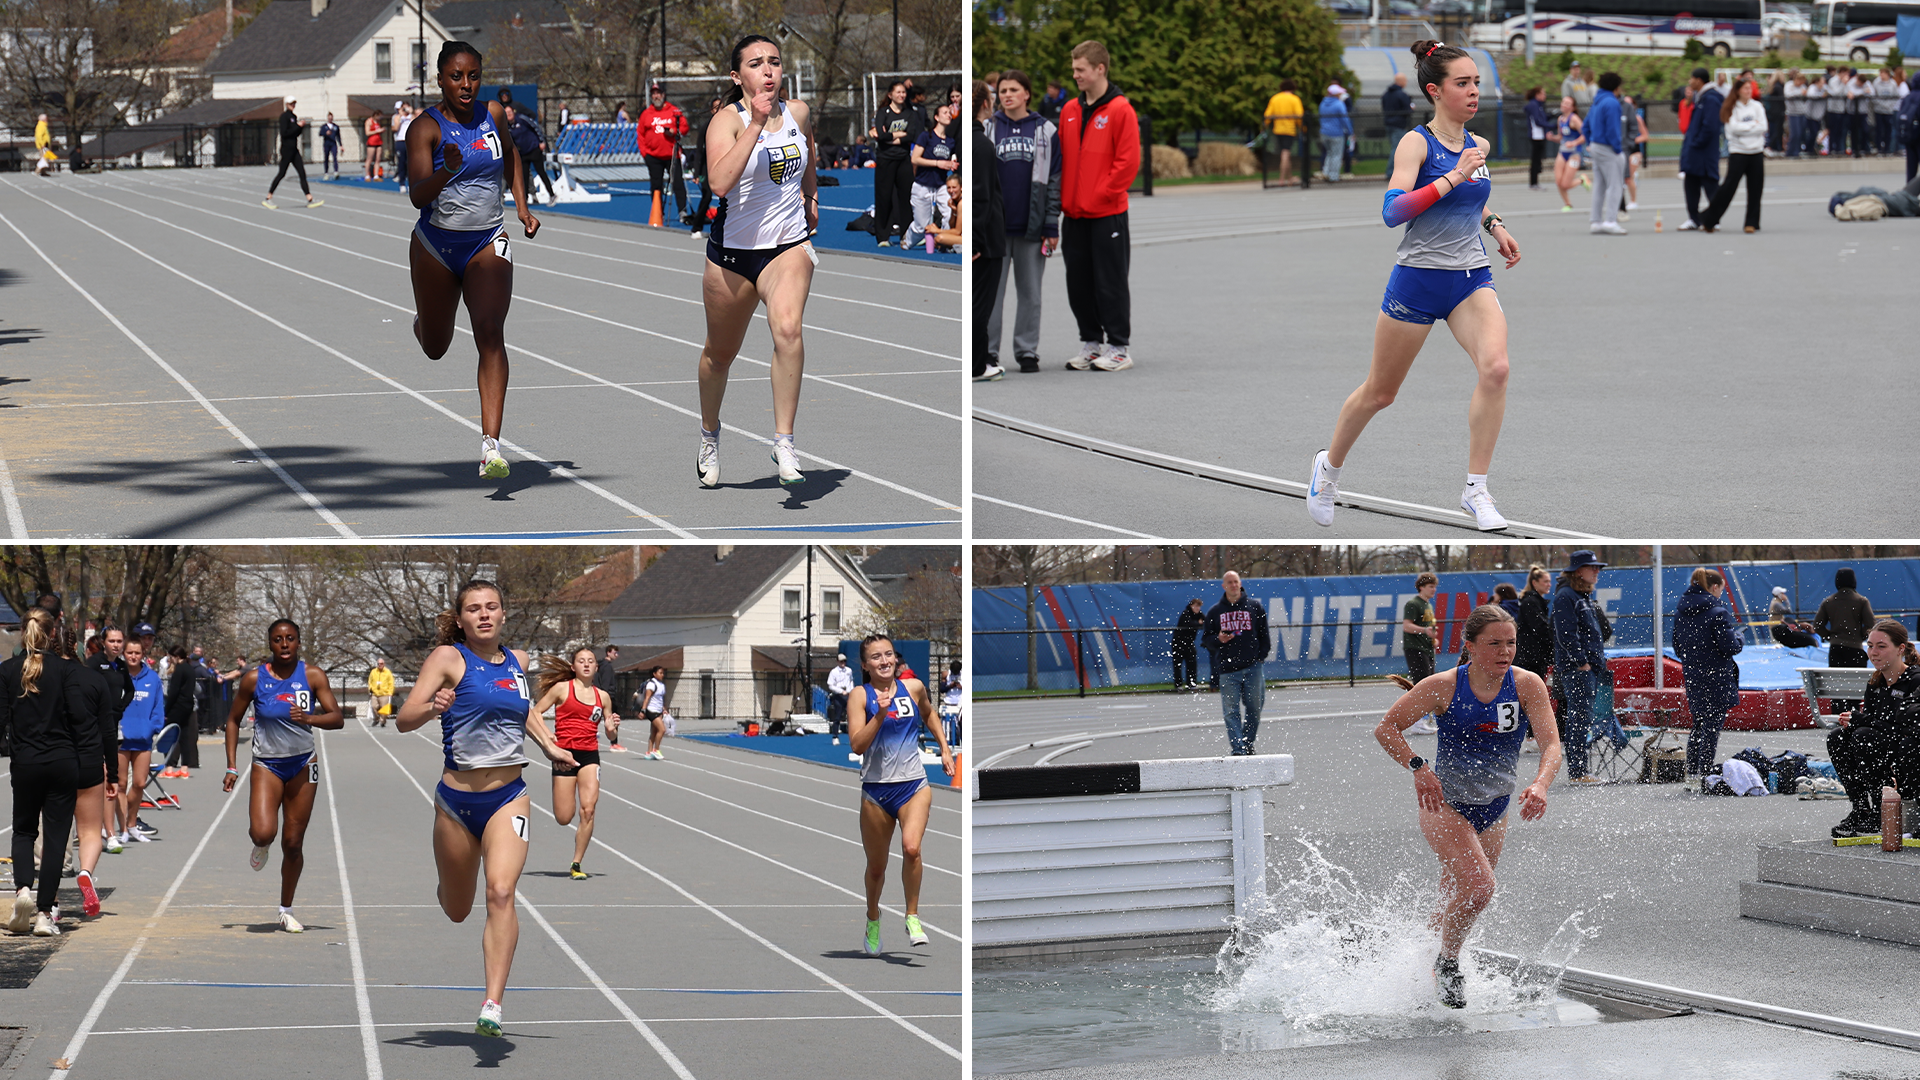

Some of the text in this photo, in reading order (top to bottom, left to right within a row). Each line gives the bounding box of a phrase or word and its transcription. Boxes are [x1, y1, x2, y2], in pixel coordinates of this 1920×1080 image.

[487, 133, 499, 157] 7
[498, 239, 508, 256] 7
[1220, 611, 1251, 622] RIVER
[1221, 621, 1252, 631] HAWKS
[1250, 593, 1420, 662] NITE
[517, 675, 527, 698] 7
[300, 692, 308, 710] 8
[899, 699, 910, 715] 5
[592, 708, 601, 722] 6
[1502, 704, 1514, 731] 3
[312, 764, 318, 781] 8
[516, 816, 525, 837] 7
